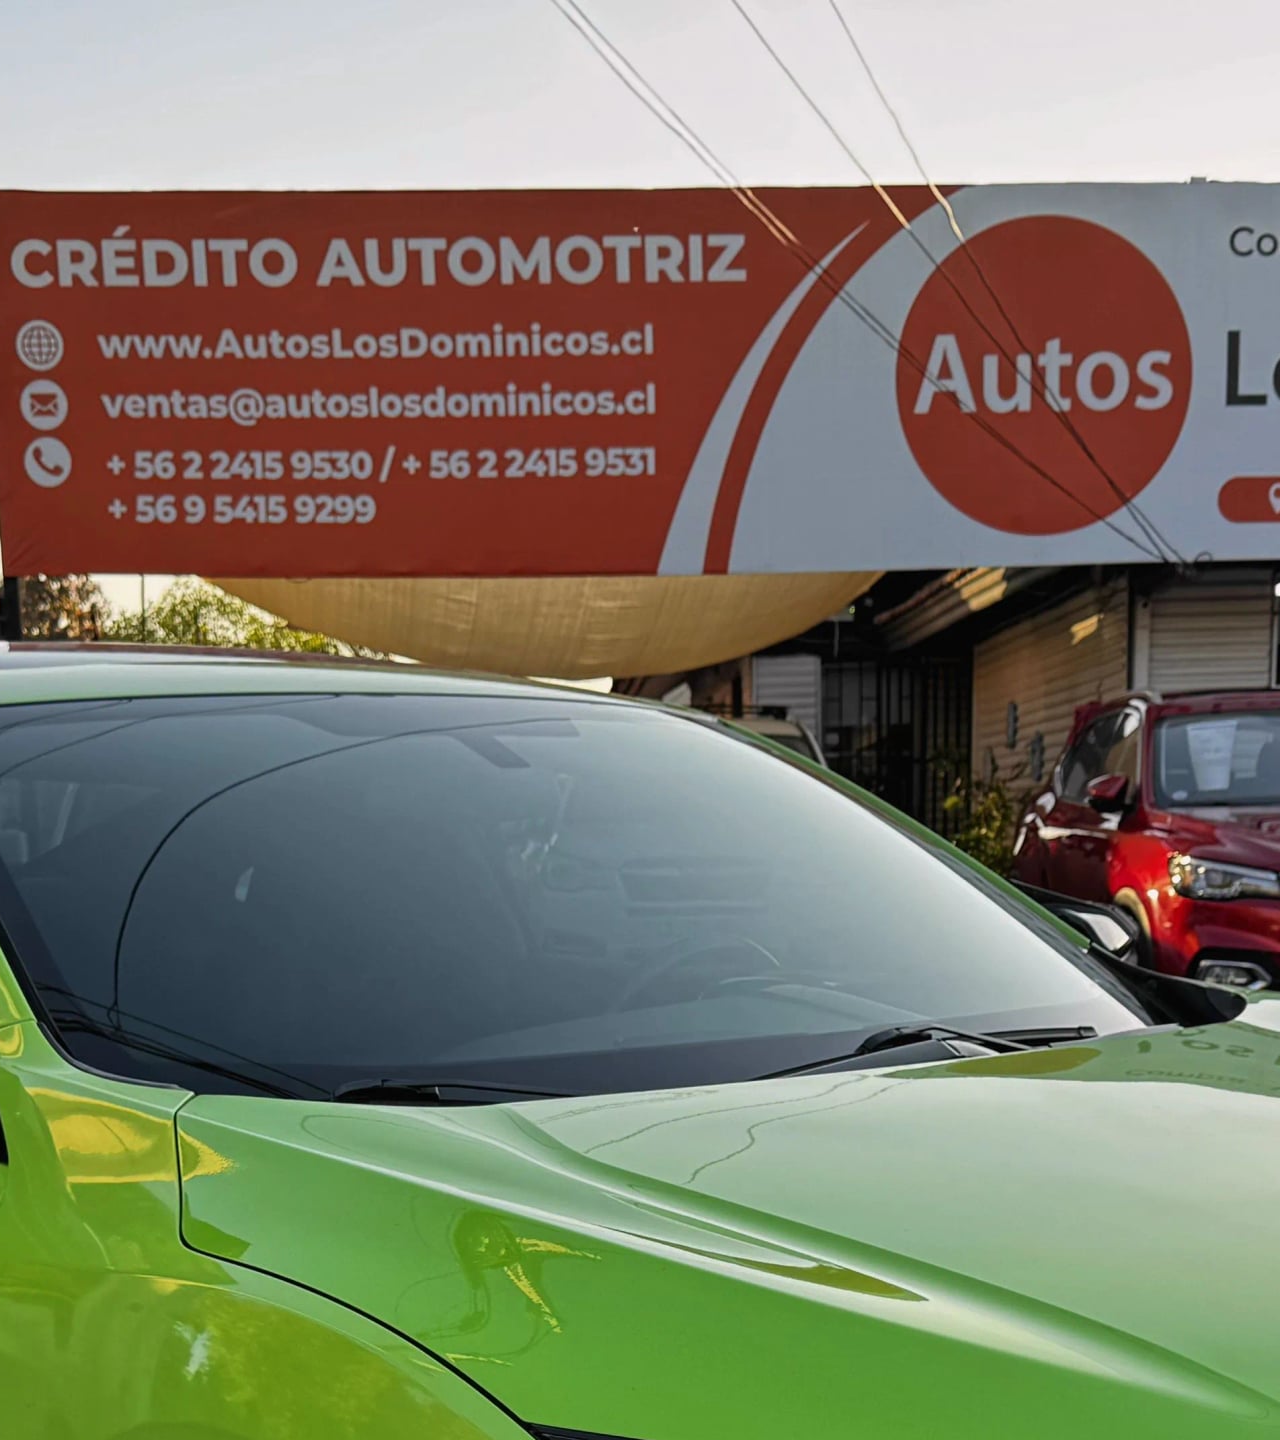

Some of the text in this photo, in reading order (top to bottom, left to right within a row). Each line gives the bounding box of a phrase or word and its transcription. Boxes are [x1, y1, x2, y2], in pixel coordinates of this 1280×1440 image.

[10, 225, 747, 288] CRÉDITO AUTOMOTRIZ
[97, 322, 654, 359] www.AutosLosDominicos.cl
[913, 333, 1174, 415] Autos
[100, 381, 656, 427] ventas@autoslosdominicos.cl
[106, 444, 656, 483] + 56 2 2415 9530 / + 56 2 2415 9531
[107, 494, 377, 524] + 56 9 5415 9299
